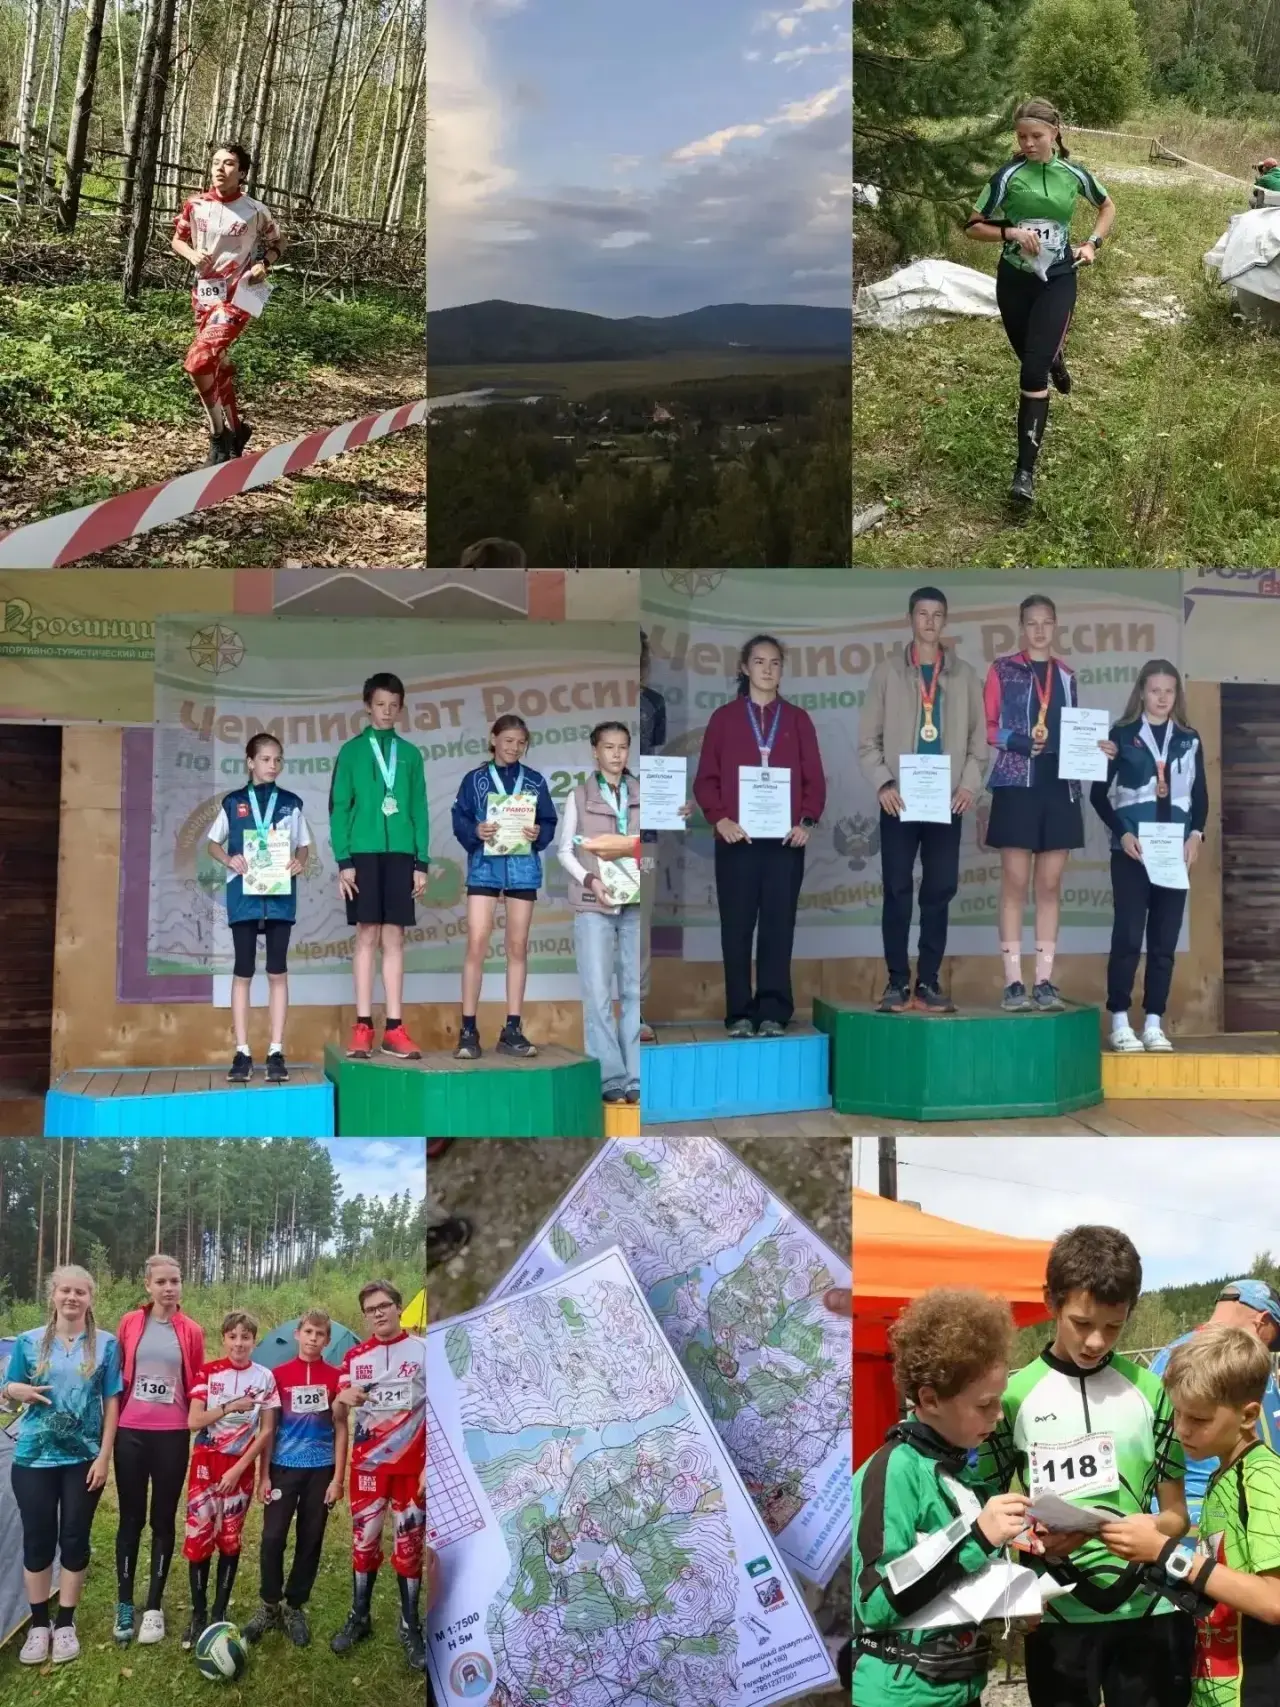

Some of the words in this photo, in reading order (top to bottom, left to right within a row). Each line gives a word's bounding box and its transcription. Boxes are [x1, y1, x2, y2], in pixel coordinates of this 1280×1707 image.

[0, 646, 136, 658] ПОРТИВНО-ТУРИСТИЧЕСКИЙ
[980, 622, 1156, 662] Рссии
[179, 697, 465, 744] Чемпиоат
[175, 750, 212, 770] по
[502, 806, 535, 814] ГРАМОТА
[141, 1382, 167, 1395] 130
[377, 1391, 402, 1401] 121
[296, 1393, 320, 1405] 128
[1042, 1455, 1098, 1483] 118
[447, 1612, 480, 1635] 1:7500
[741, 1648, 778, 1668] Аварийный
[771, 1652, 822, 1676] организаторов
